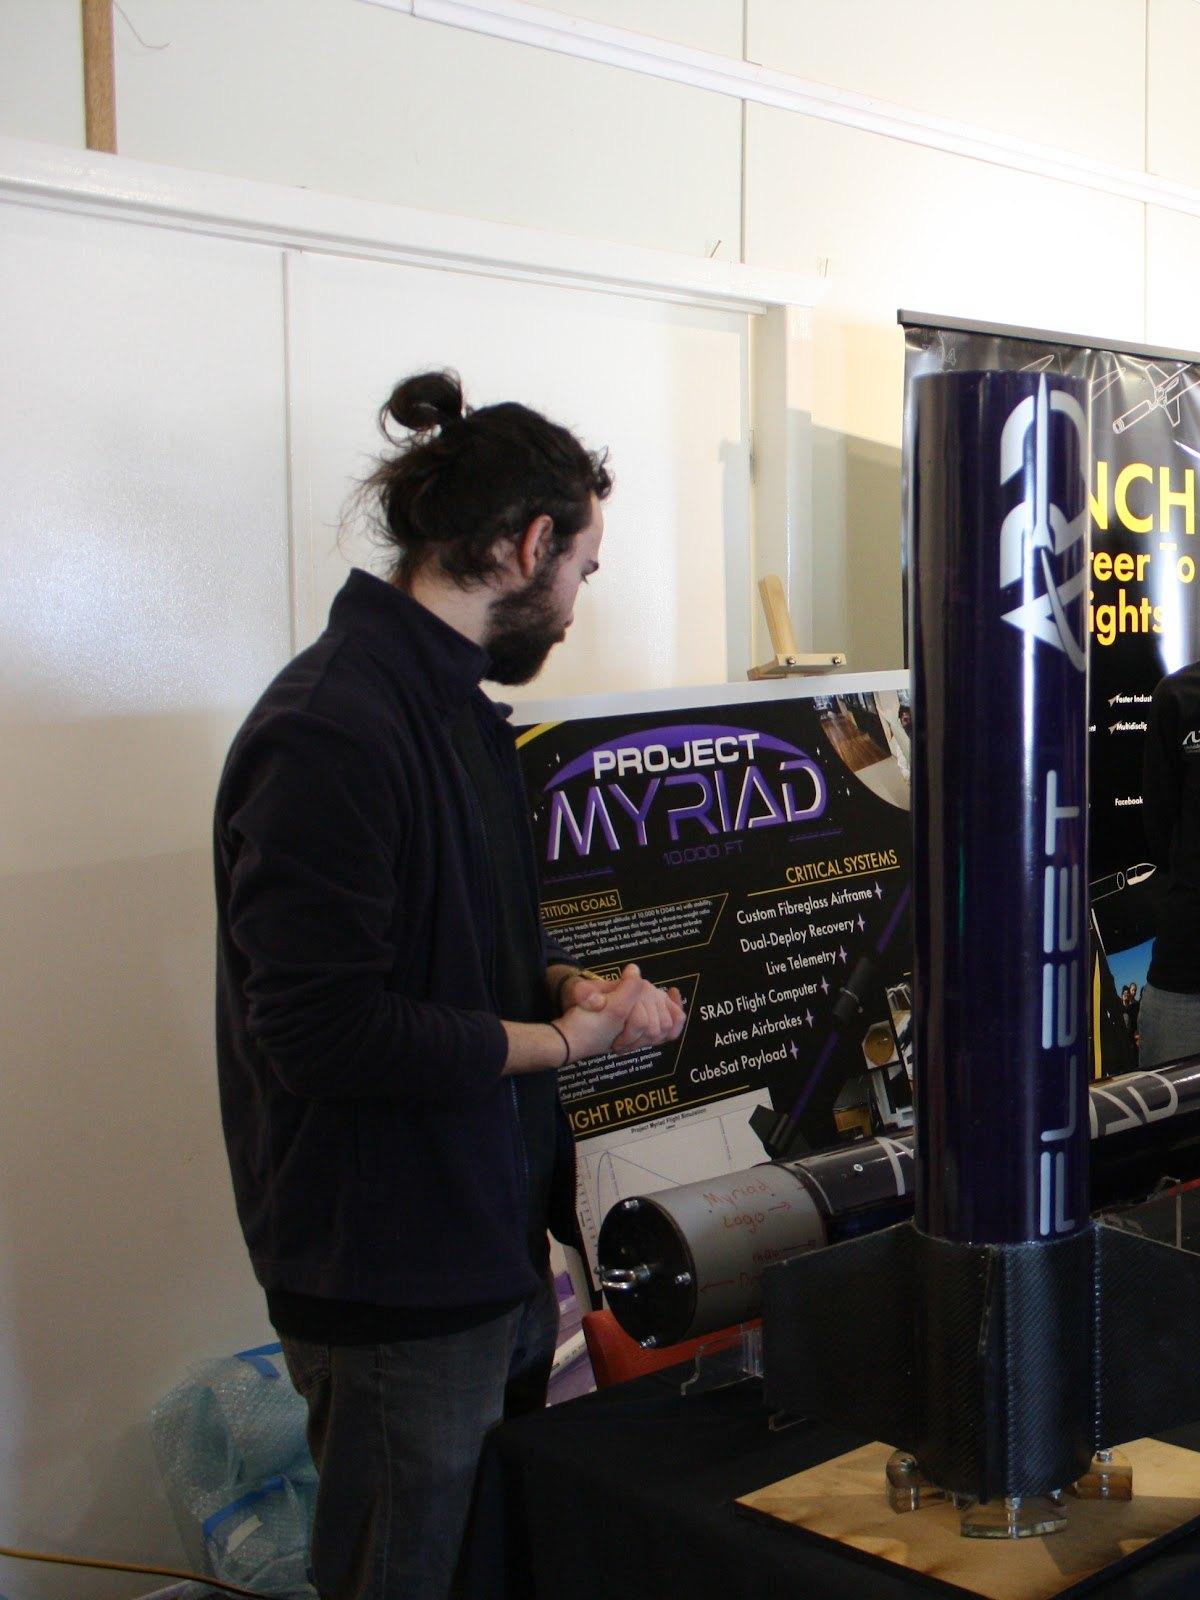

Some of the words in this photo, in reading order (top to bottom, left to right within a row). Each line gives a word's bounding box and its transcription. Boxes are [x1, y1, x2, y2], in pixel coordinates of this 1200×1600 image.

[1089, 552, 1151, 582] eer
[593, 733, 760, 779] PROJECT
[546, 758, 828, 862] MYRIAD
[1114, 796, 1144, 806] Facebook
[725, 839, 744, 856] FT
[785, 860, 843, 884] CRITICAL
[843, 849, 898, 872] SYSTEMS
[580, 894, 617, 913] GOALS
[736, 908, 777, 925] Custom
[778, 893, 829, 917] Fibreglass
[830, 888, 873, 907] Airframe
[740, 929, 807, 953] Dual-Deploy
[809, 918, 855, 937] Recovery
[766, 960, 787, 976] Live
[787, 949, 837, 971] Telemetry
[700, 1000, 734, 1021] SRAD
[736, 993, 767, 1014] Flight
[769, 982, 818, 1004] Computer
[714, 1028, 749, 1048] Active
[751, 1015, 803, 1037] Airbrakes
[690, 1060, 740, 1084] CubeSat
[742, 1044, 788, 1069] Payload
[612, 1084, 679, 1118] PROFILE
[631, 1125, 649, 1134] Project
[649, 1119, 665, 1129] Myriad
[666, 1114, 680, 1123] Flight
[681, 1108, 707, 1119] Simulation
[703, 1178, 768, 1210] Myriad
[721, 1211, 766, 1234] Logo
